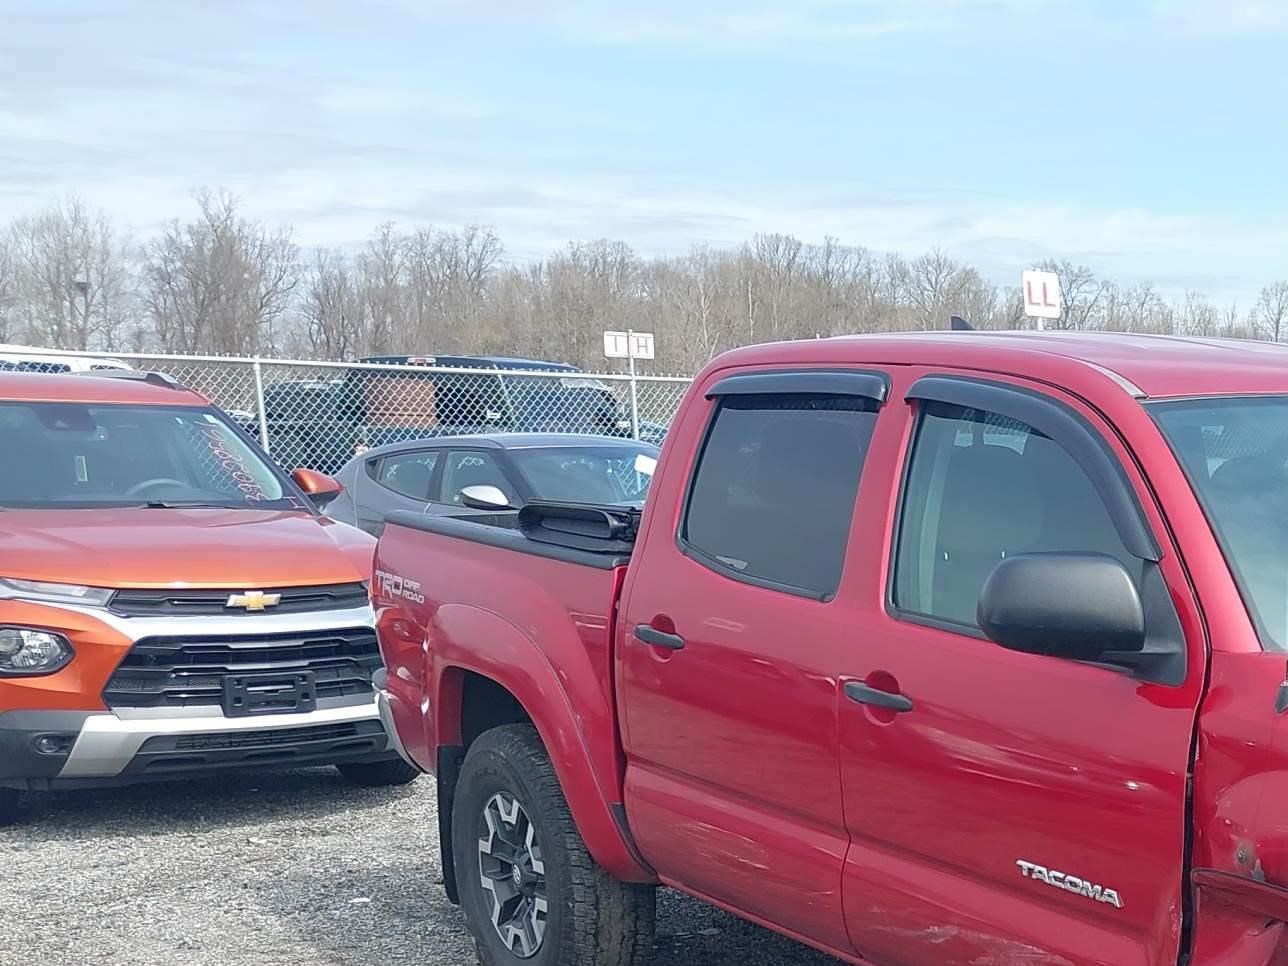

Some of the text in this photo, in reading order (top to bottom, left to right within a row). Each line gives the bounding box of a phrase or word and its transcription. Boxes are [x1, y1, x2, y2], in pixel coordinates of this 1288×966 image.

[1026, 280, 1057, 308] LL
[636, 336, 649, 354] H
[375, 569, 421, 599] TRD OFF
[402, 589, 425, 604] ROAD
[1015, 859, 1125, 908] TACOMA
